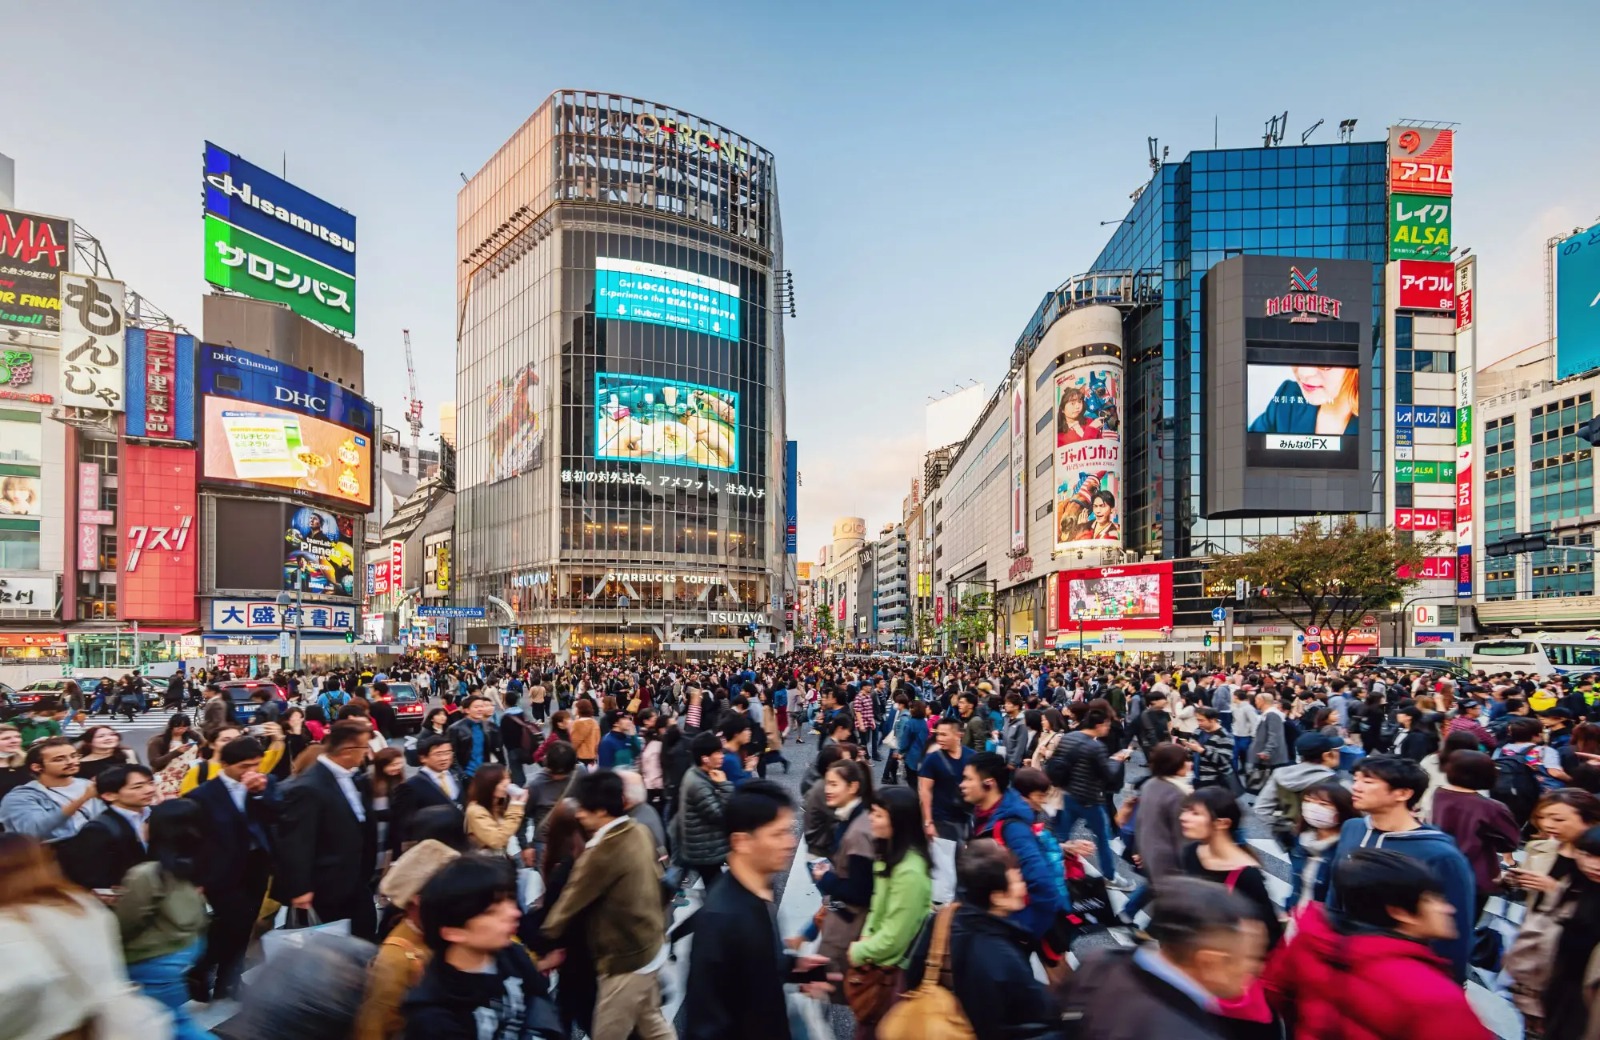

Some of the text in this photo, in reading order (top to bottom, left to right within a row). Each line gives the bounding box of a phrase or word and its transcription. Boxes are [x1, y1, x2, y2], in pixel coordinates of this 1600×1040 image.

[1400, 162, 1452, 183] アコム
[207, 174, 355, 253] Hisamitsu
[1396, 202, 1448, 224] レイク
[1394, 225, 1449, 245] ALSA
[215, 240, 351, 313] サロンパス
[1401, 275, 1453, 291] アイフル
[619, 279, 718, 305] Get LOCAL GUIDES &
[600, 288, 736, 320] Experience the REAL SHIBUYA
[1266, 294, 1342, 319] MAGNET
[1440, 299, 1453, 308] 8F
[1460, 299, 1469, 326] アイフル
[666, 313, 690, 324] Japan
[64, 278, 121, 407] もんじゃ
[213, 352, 279, 373] DHC Channel
[146, 333, 169, 432] 三千里薬品
[275, 386, 326, 412] DHC
[1397, 411, 1450, 424] レオパレス21
[1279, 439, 1327, 449] みんなのFX
[1459, 482, 1469, 506] アコム
[1400, 513, 1437, 525] アコム
[787, 515, 796, 546] SEIBU
[125, 515, 193, 572] クスリ
[300, 542, 341, 558] Planets
[608, 573, 722, 585] STARBUCKS COFFEE
[1460, 554, 1469, 583] PROMISE
[710, 612, 765, 624] TSUTAYA
[1417, 606, 1434, 623] 0円
